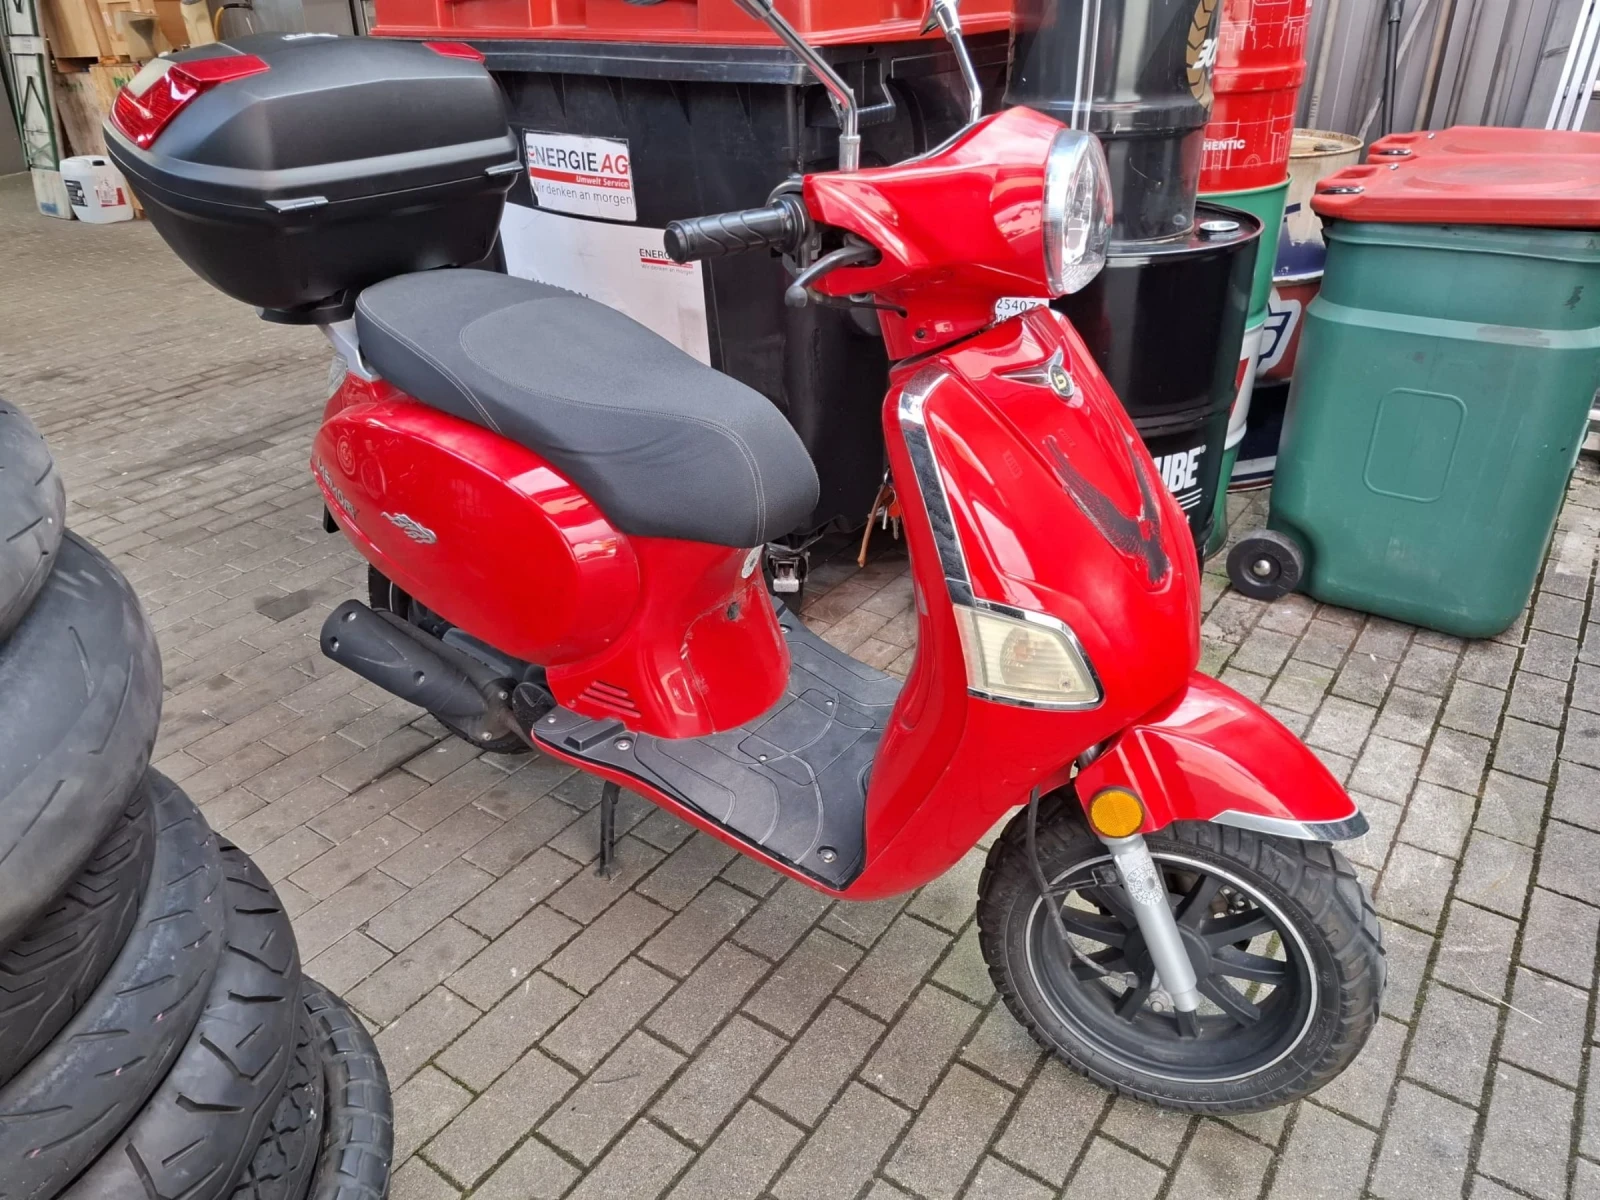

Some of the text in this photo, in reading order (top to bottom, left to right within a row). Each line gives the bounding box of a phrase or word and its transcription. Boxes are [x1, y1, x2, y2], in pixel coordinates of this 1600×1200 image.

[527, 145, 629, 175] ENERGIE AG
[575, 175, 630, 188] Umwelt Service
[546, 183, 578, 199] denken
[580, 191, 591, 201] an
[593, 193, 633, 207] morgen
